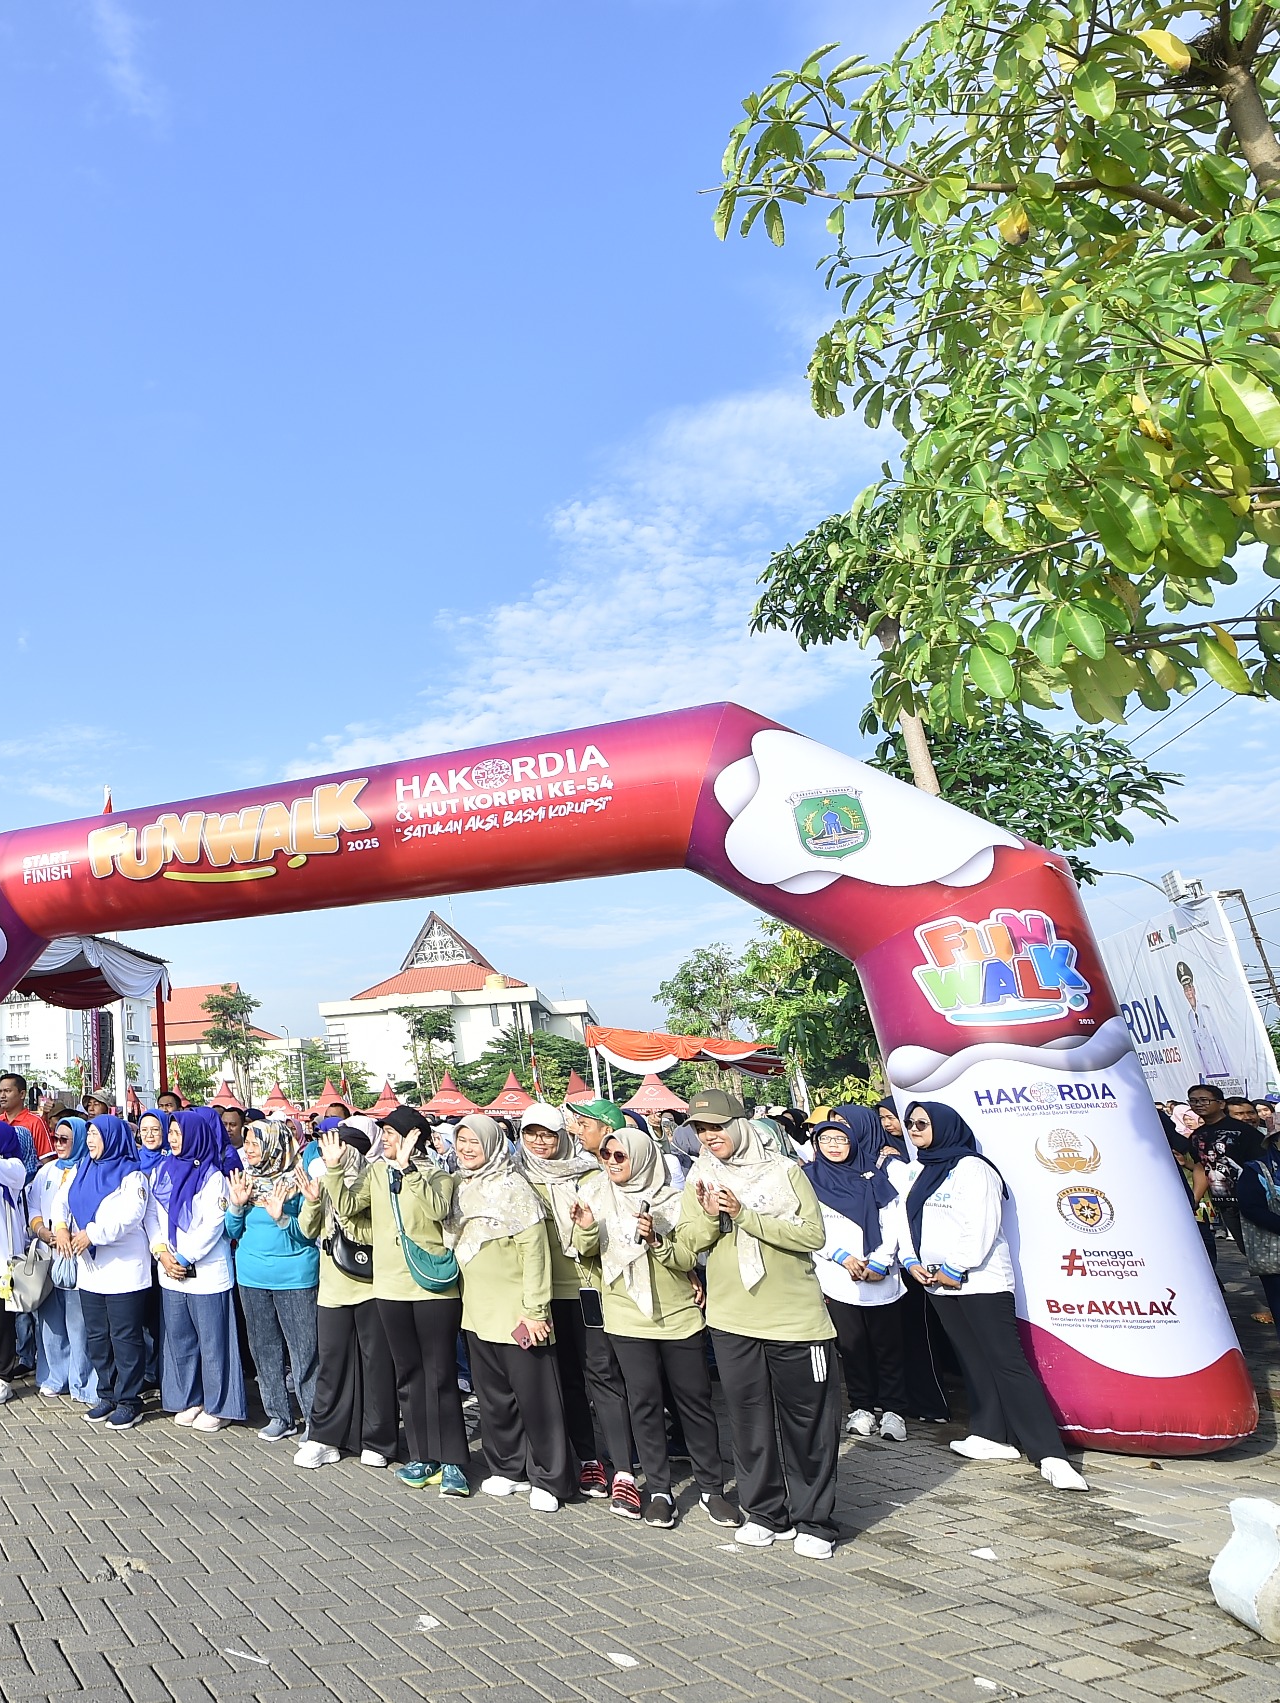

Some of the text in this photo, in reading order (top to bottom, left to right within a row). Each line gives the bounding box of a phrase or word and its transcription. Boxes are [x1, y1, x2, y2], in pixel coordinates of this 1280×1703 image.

[395, 774, 614, 822] & HUT KORPRI KE-54
[347, 838, 380, 852] 2025
[22, 851, 70, 870] START
[23, 864, 72, 884] FINISH
[919, 912, 1053, 968] FUN
[1147, 930, 1164, 948] KPK
[917, 943, 1088, 1010] WALK
[1078, 1018, 1096, 1026] 2025
[1004, 1103, 1063, 1114] ANTIKORUPSI
[1083, 1248, 1133, 1259] bangga
[1086, 1258, 1145, 1269] melayani
[1089, 1268, 1138, 1279] bangsa
[1046, 1299, 1177, 1316] BerAKHLAK
